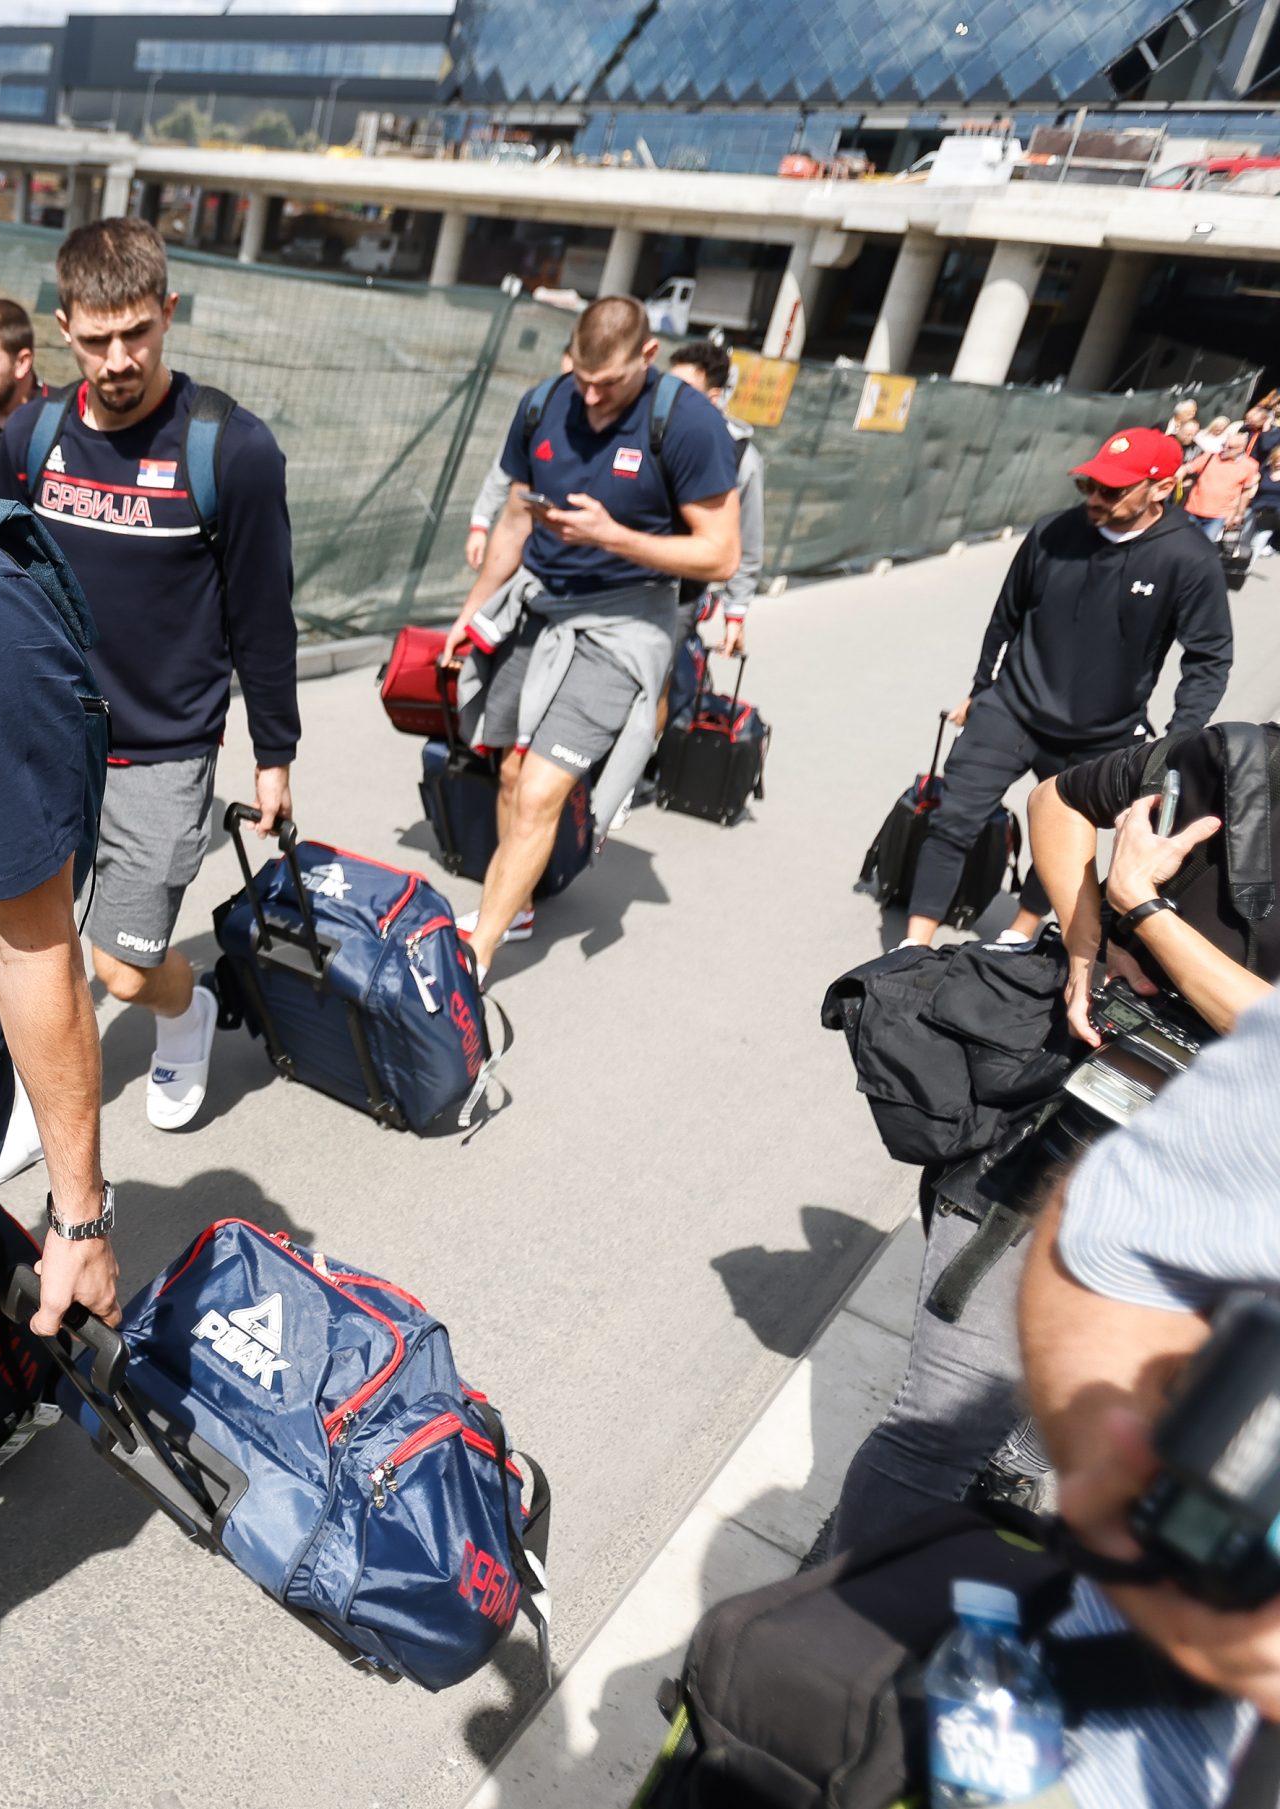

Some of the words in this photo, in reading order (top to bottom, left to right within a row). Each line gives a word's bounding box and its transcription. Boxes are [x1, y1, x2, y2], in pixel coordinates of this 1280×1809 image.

[41, 479, 153, 527] СРБИЈА
[154, 1066, 178, 1082] NIKE
[190, 1308, 292, 1391] PEAK
